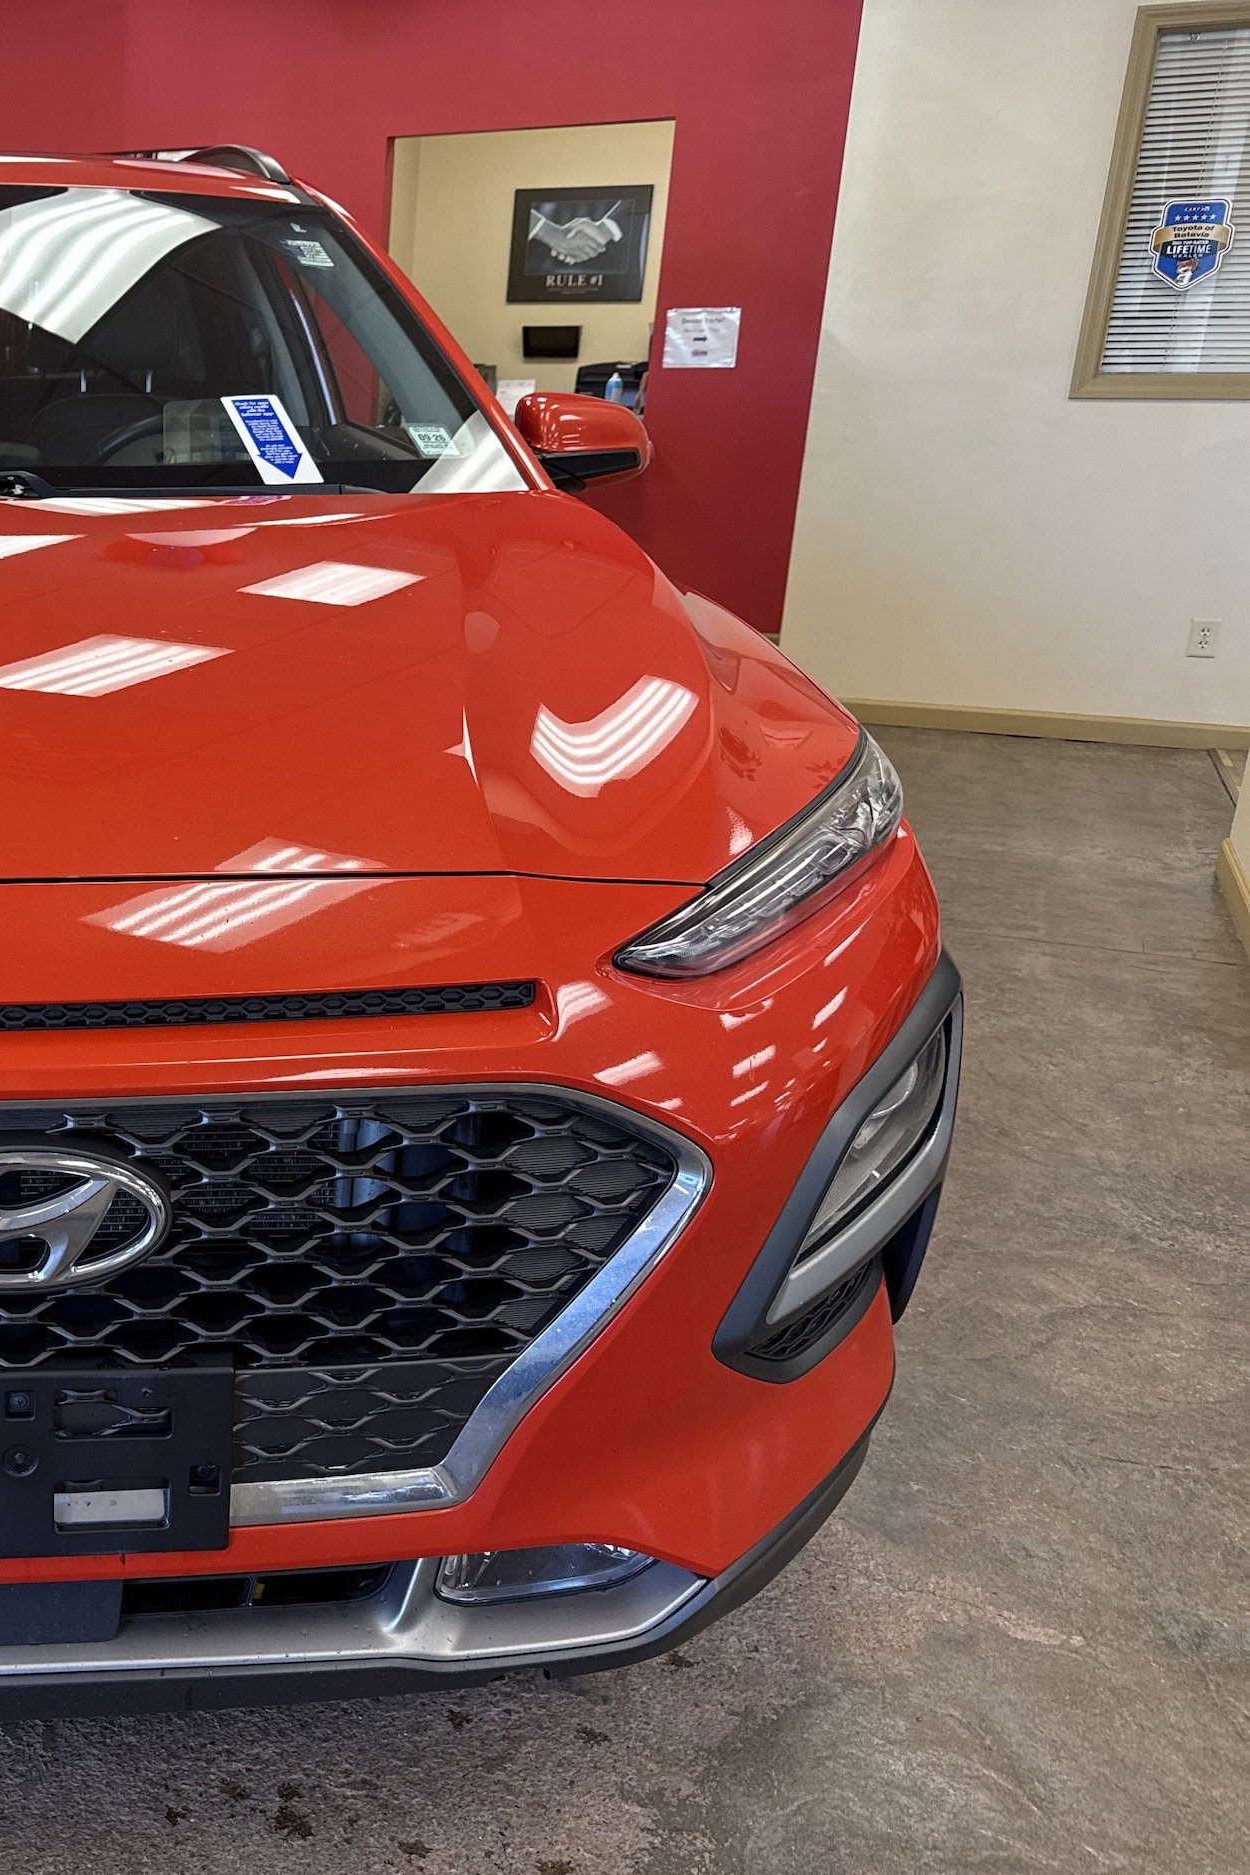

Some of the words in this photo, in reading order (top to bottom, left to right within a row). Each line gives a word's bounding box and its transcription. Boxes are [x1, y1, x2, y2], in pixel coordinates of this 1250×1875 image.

[1172, 225, 1203, 233] Toyota
[1166, 245, 1212, 255] LIFETIME
[546, 274, 587, 288] RULE
[590, 274, 604, 287] #1
